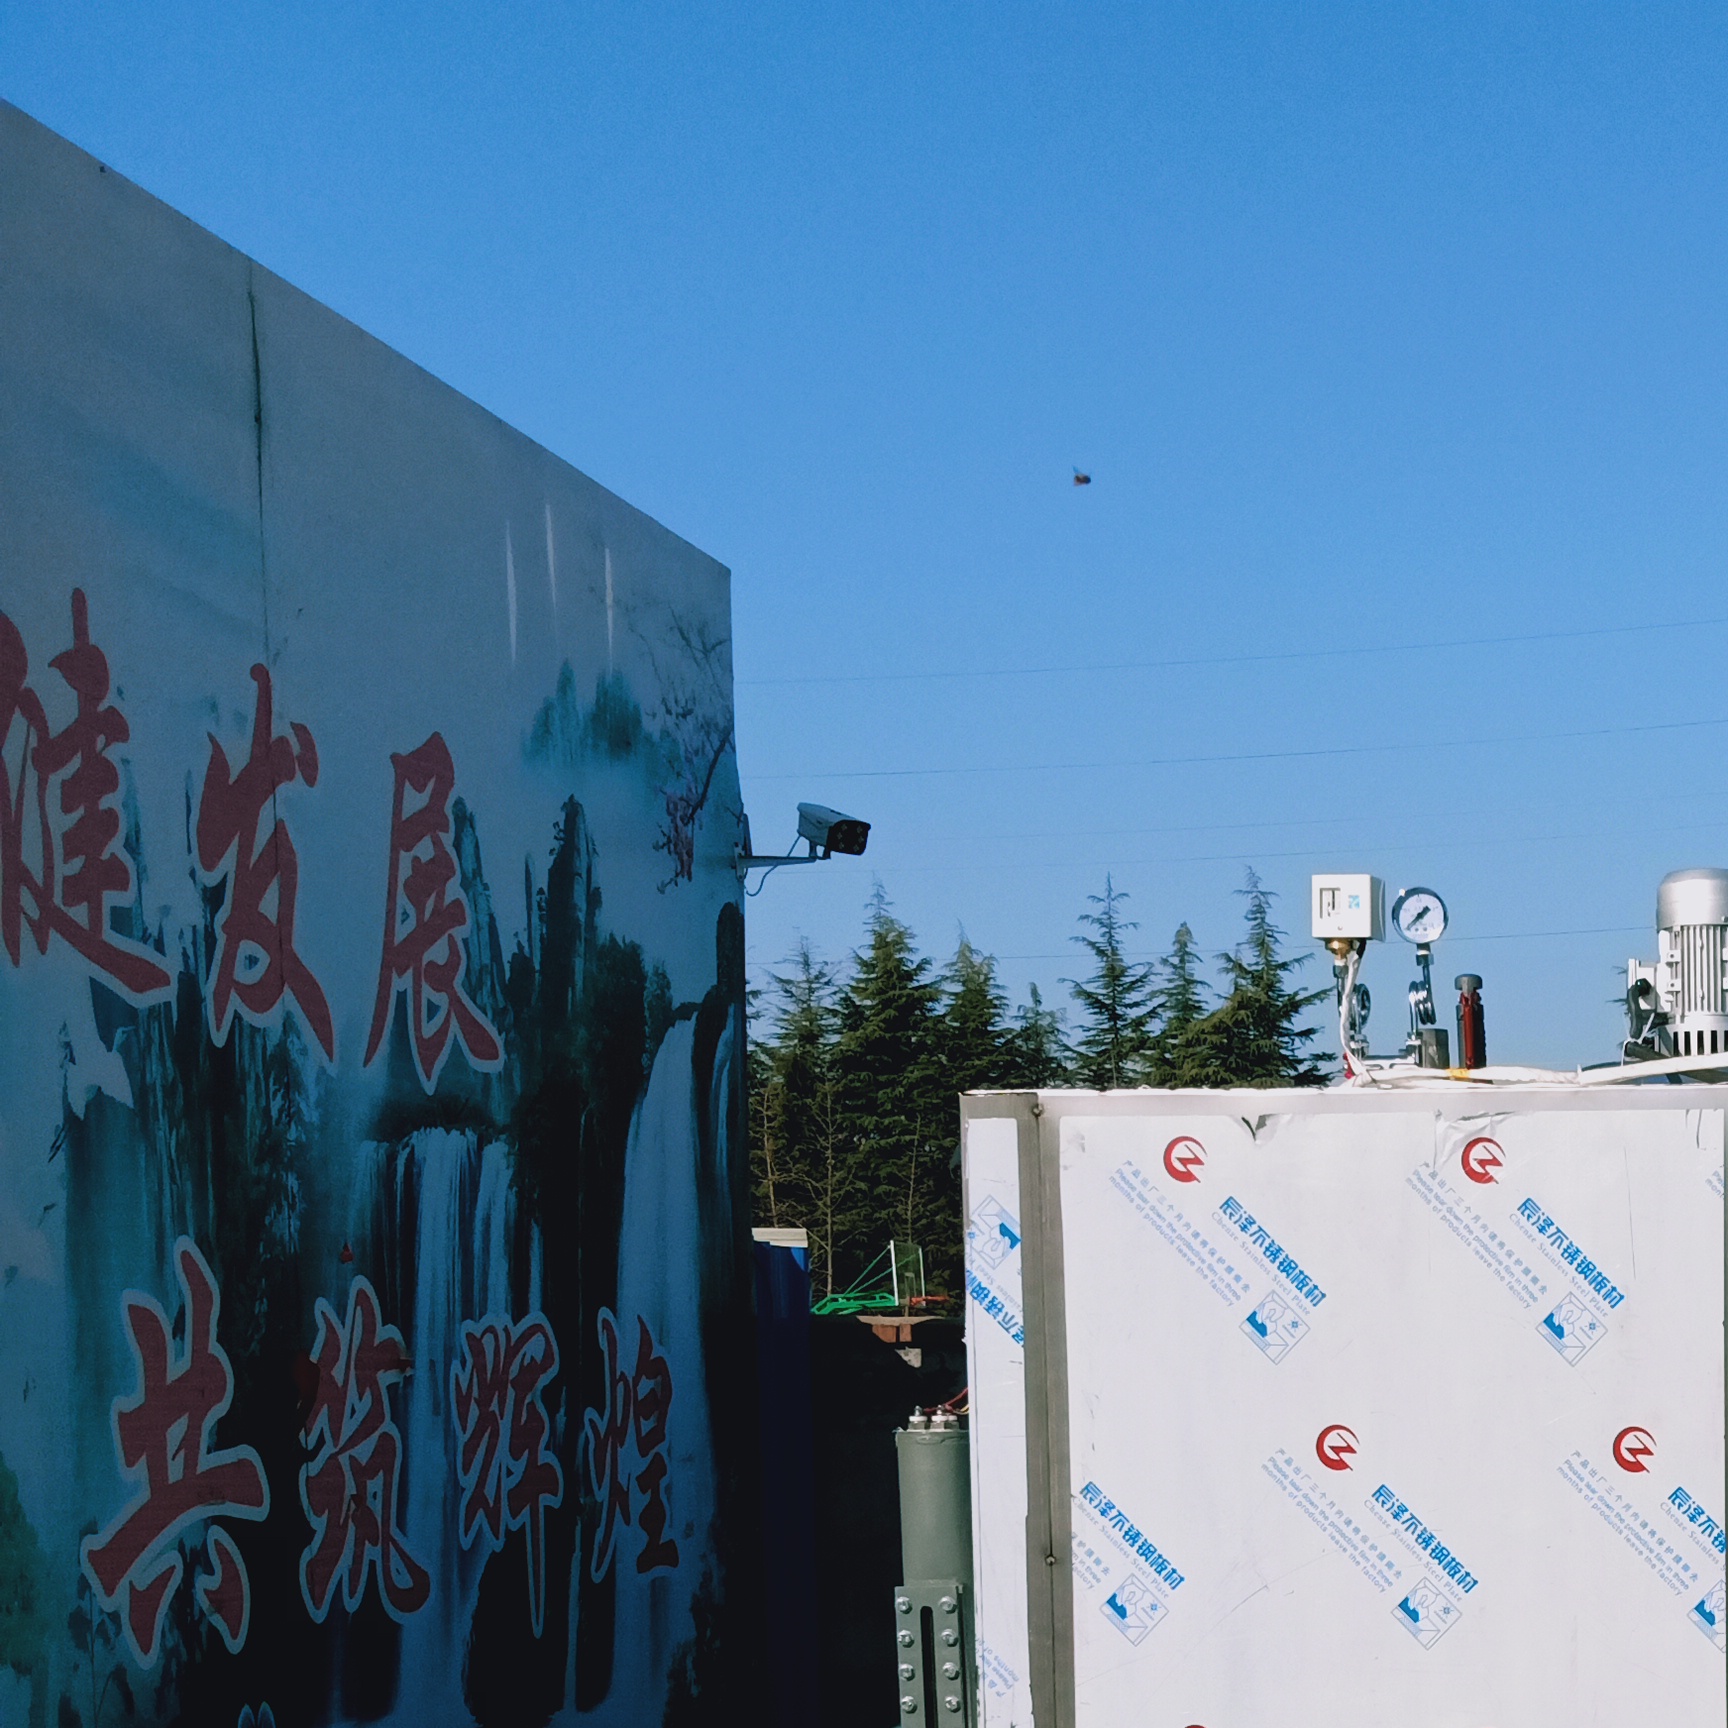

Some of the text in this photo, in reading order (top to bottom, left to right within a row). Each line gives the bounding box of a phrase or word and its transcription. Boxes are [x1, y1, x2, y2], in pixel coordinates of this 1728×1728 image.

[1218, 1195, 1326, 1307] 辰泽不锈钢板材
[1516, 1197, 1625, 1309] 辰泽不锈钢板材
[84, 1246, 682, 1660] 共筑辉煌
[1078, 1480, 1185, 1590] 辰泽不锈钢板材
[1371, 1483, 1478, 1593] 辰泽不锈钢板材
